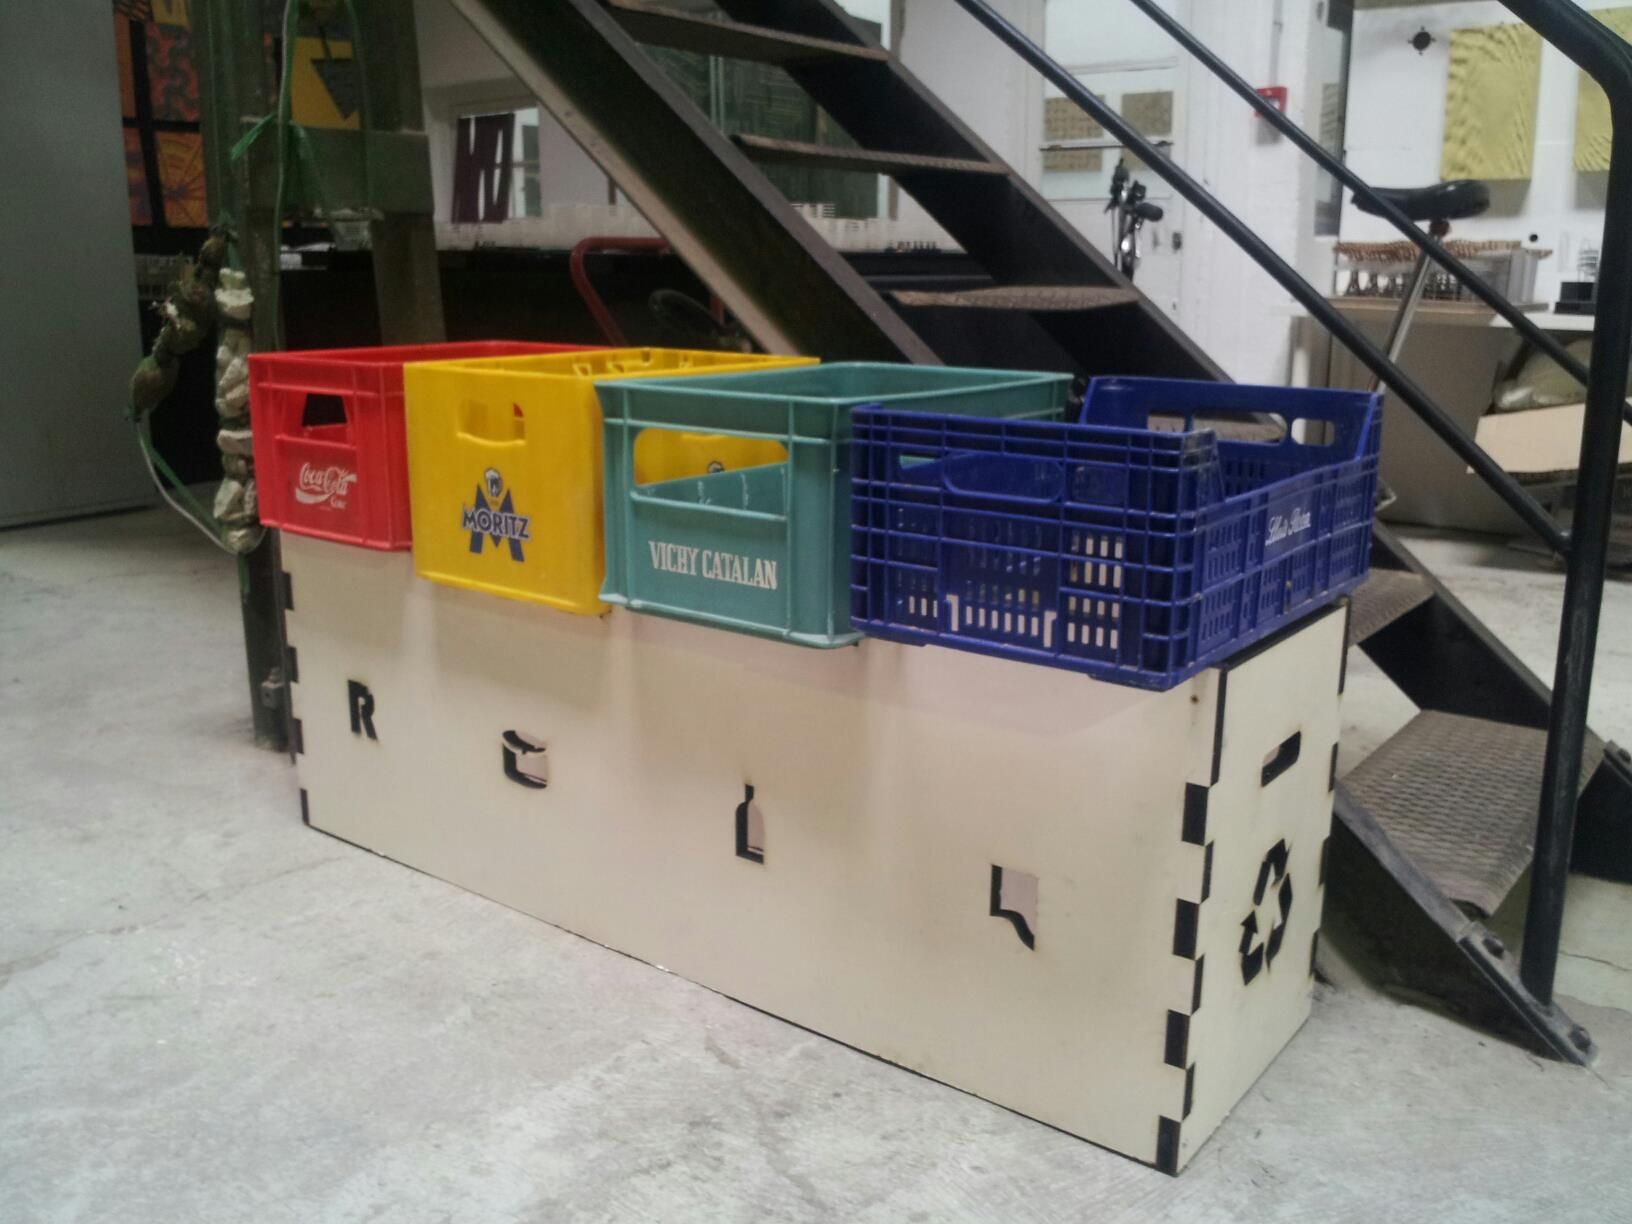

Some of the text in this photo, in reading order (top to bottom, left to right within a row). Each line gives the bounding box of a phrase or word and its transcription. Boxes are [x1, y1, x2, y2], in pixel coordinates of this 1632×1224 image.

[462, 506, 531, 540] MORITZ
[648, 541, 778, 590] VICHY CATALAN
[347, 679, 378, 740] R
